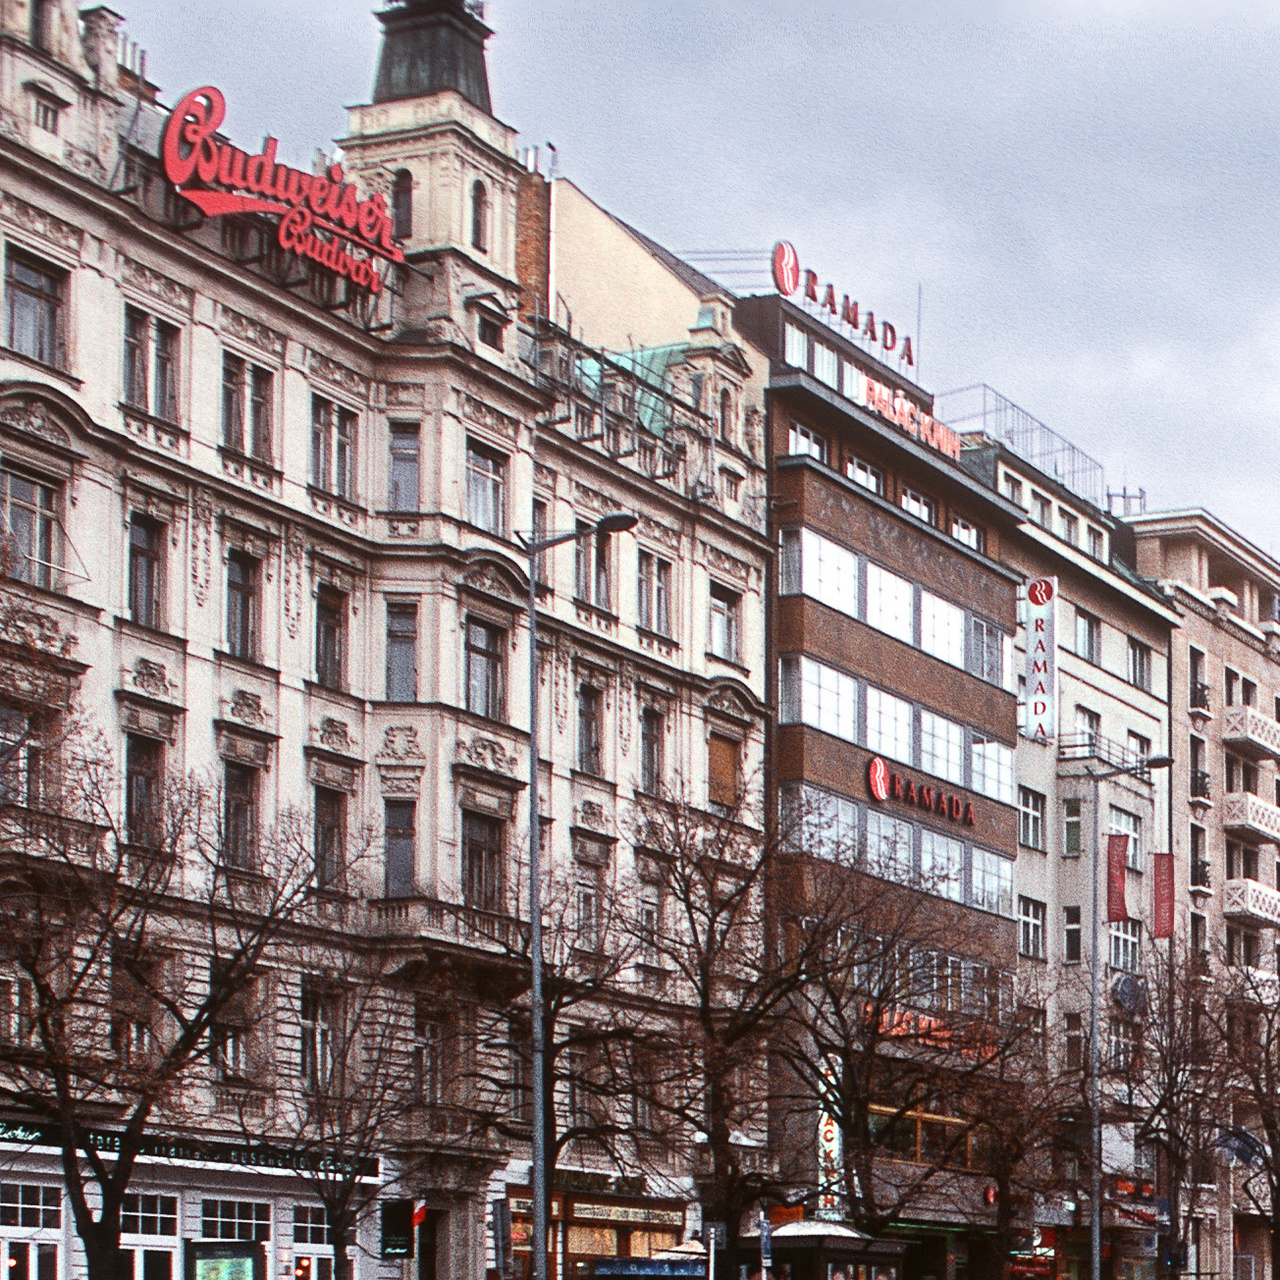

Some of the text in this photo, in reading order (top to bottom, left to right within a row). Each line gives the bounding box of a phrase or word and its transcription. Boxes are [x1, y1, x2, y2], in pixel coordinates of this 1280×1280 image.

[163, 85, 400, 252] Budweiser
[804, 268, 914, 367] RAMADA
[1032, 618, 1048, 738] RAMADA
[894, 774, 975, 826] RAMADA
